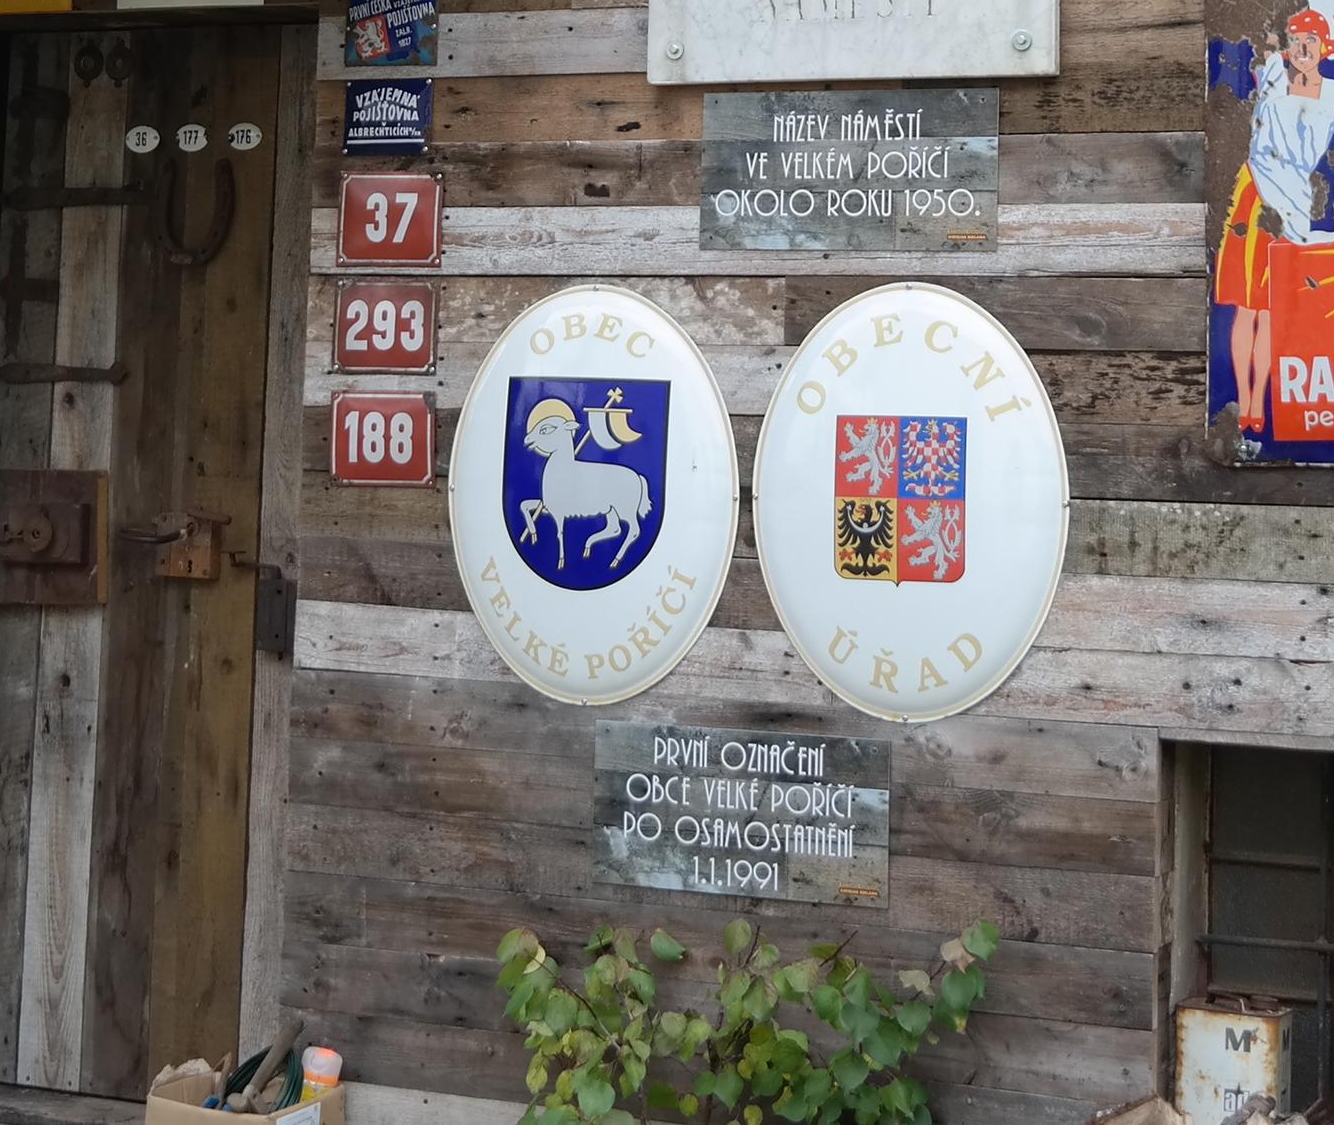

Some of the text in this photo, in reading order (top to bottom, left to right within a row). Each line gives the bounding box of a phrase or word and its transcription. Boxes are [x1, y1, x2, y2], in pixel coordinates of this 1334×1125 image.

[356, 87, 421, 108] VZÁJEMNÁ
[135, 129, 251, 147] 36 177 176
[773, 109, 924, 142] NÁZEV NÁMĚSTÍ
[746, 147, 951, 179] VE VELKÉM POŘÍČÍ
[365, 192, 418, 243] 37
[716, 188, 981, 217] OKOLO ROKU 1950.
[346, 299, 425, 352] 293
[529, 312, 655, 358] OBEC
[796, 312, 1032, 422] OBECNÍ
[344, 411, 413, 464] 188
[477, 556, 697, 680] VELKÉ POŘÍČÍ
[827, 626, 984, 693] ÚŘAD
[654, 736, 826, 776] PRVNÍ OZNAČENÍ
[626, 773, 854, 818] OBCE VELKÉ POŘÍČÍ
[623, 811, 855, 858] PO OSAMOSTATNĚNÍ
[693, 856, 779, 891] 1.1.1991
